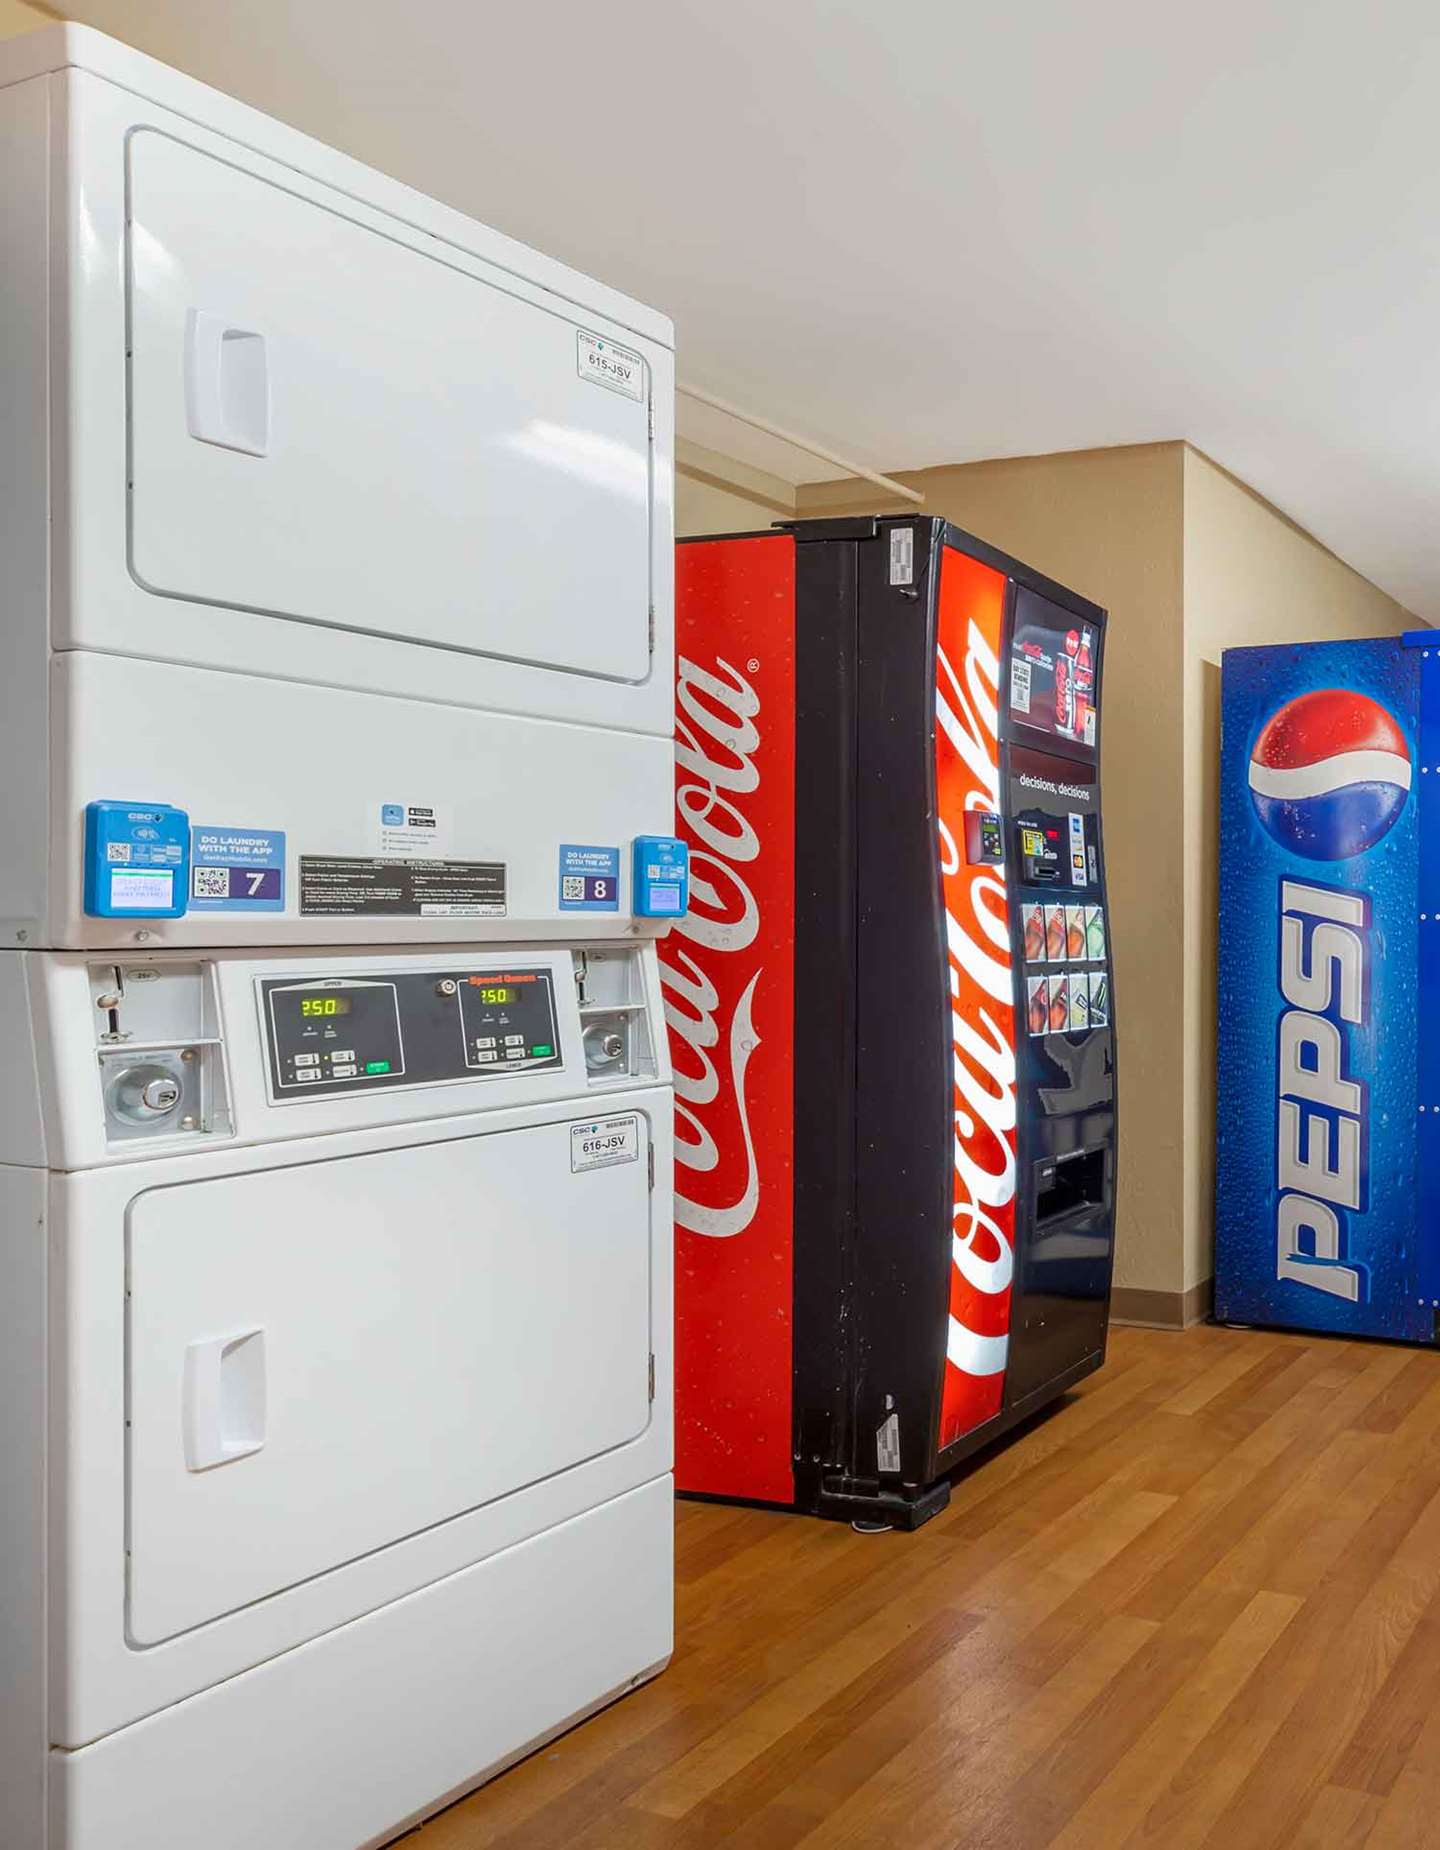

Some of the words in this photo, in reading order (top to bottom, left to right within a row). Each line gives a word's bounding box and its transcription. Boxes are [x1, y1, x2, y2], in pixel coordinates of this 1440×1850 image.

[1020, 773, 1058, 795] decisions,
[1058, 782, 1090, 801] decisions
[197, 844, 229, 853] WITH
[230, 845, 251, 854] THE
[252, 847, 273, 855] APP
[201, 835, 217, 844] DO
[219, 836, 270, 847] LAUNDRY
[245, 872, 266, 896] 7
[594, 880, 607, 899] 8
[1277, 879, 1365, 1303] PEPSI
[573, 1126, 591, 1136] CSC
[582, 1135, 626, 1153] 616-JSV
